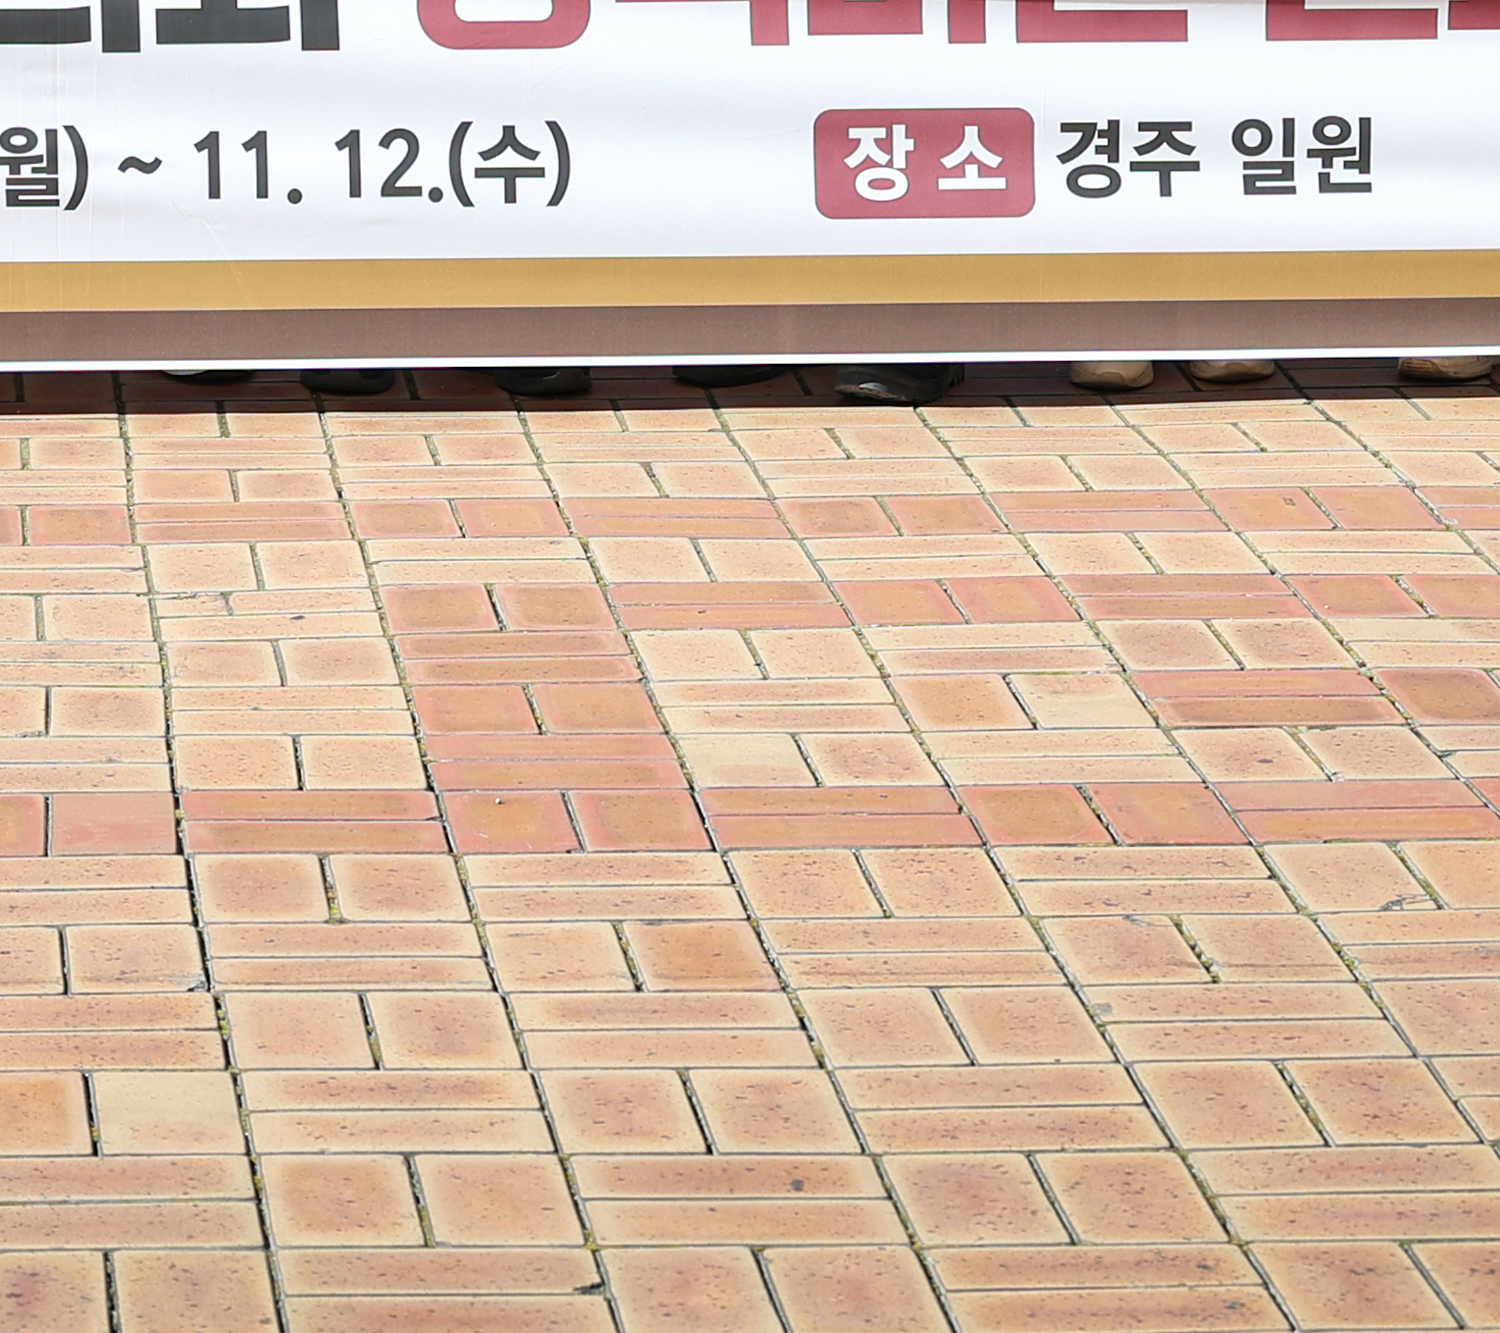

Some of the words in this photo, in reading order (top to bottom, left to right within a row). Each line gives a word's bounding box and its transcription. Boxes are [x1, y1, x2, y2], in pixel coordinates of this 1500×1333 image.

[193, 130, 304, 205] 11.
[335, 120, 572, 209] 12.(수)
[1056, 118, 1202, 200] 경주
[1231, 115, 1374, 197] 일원
